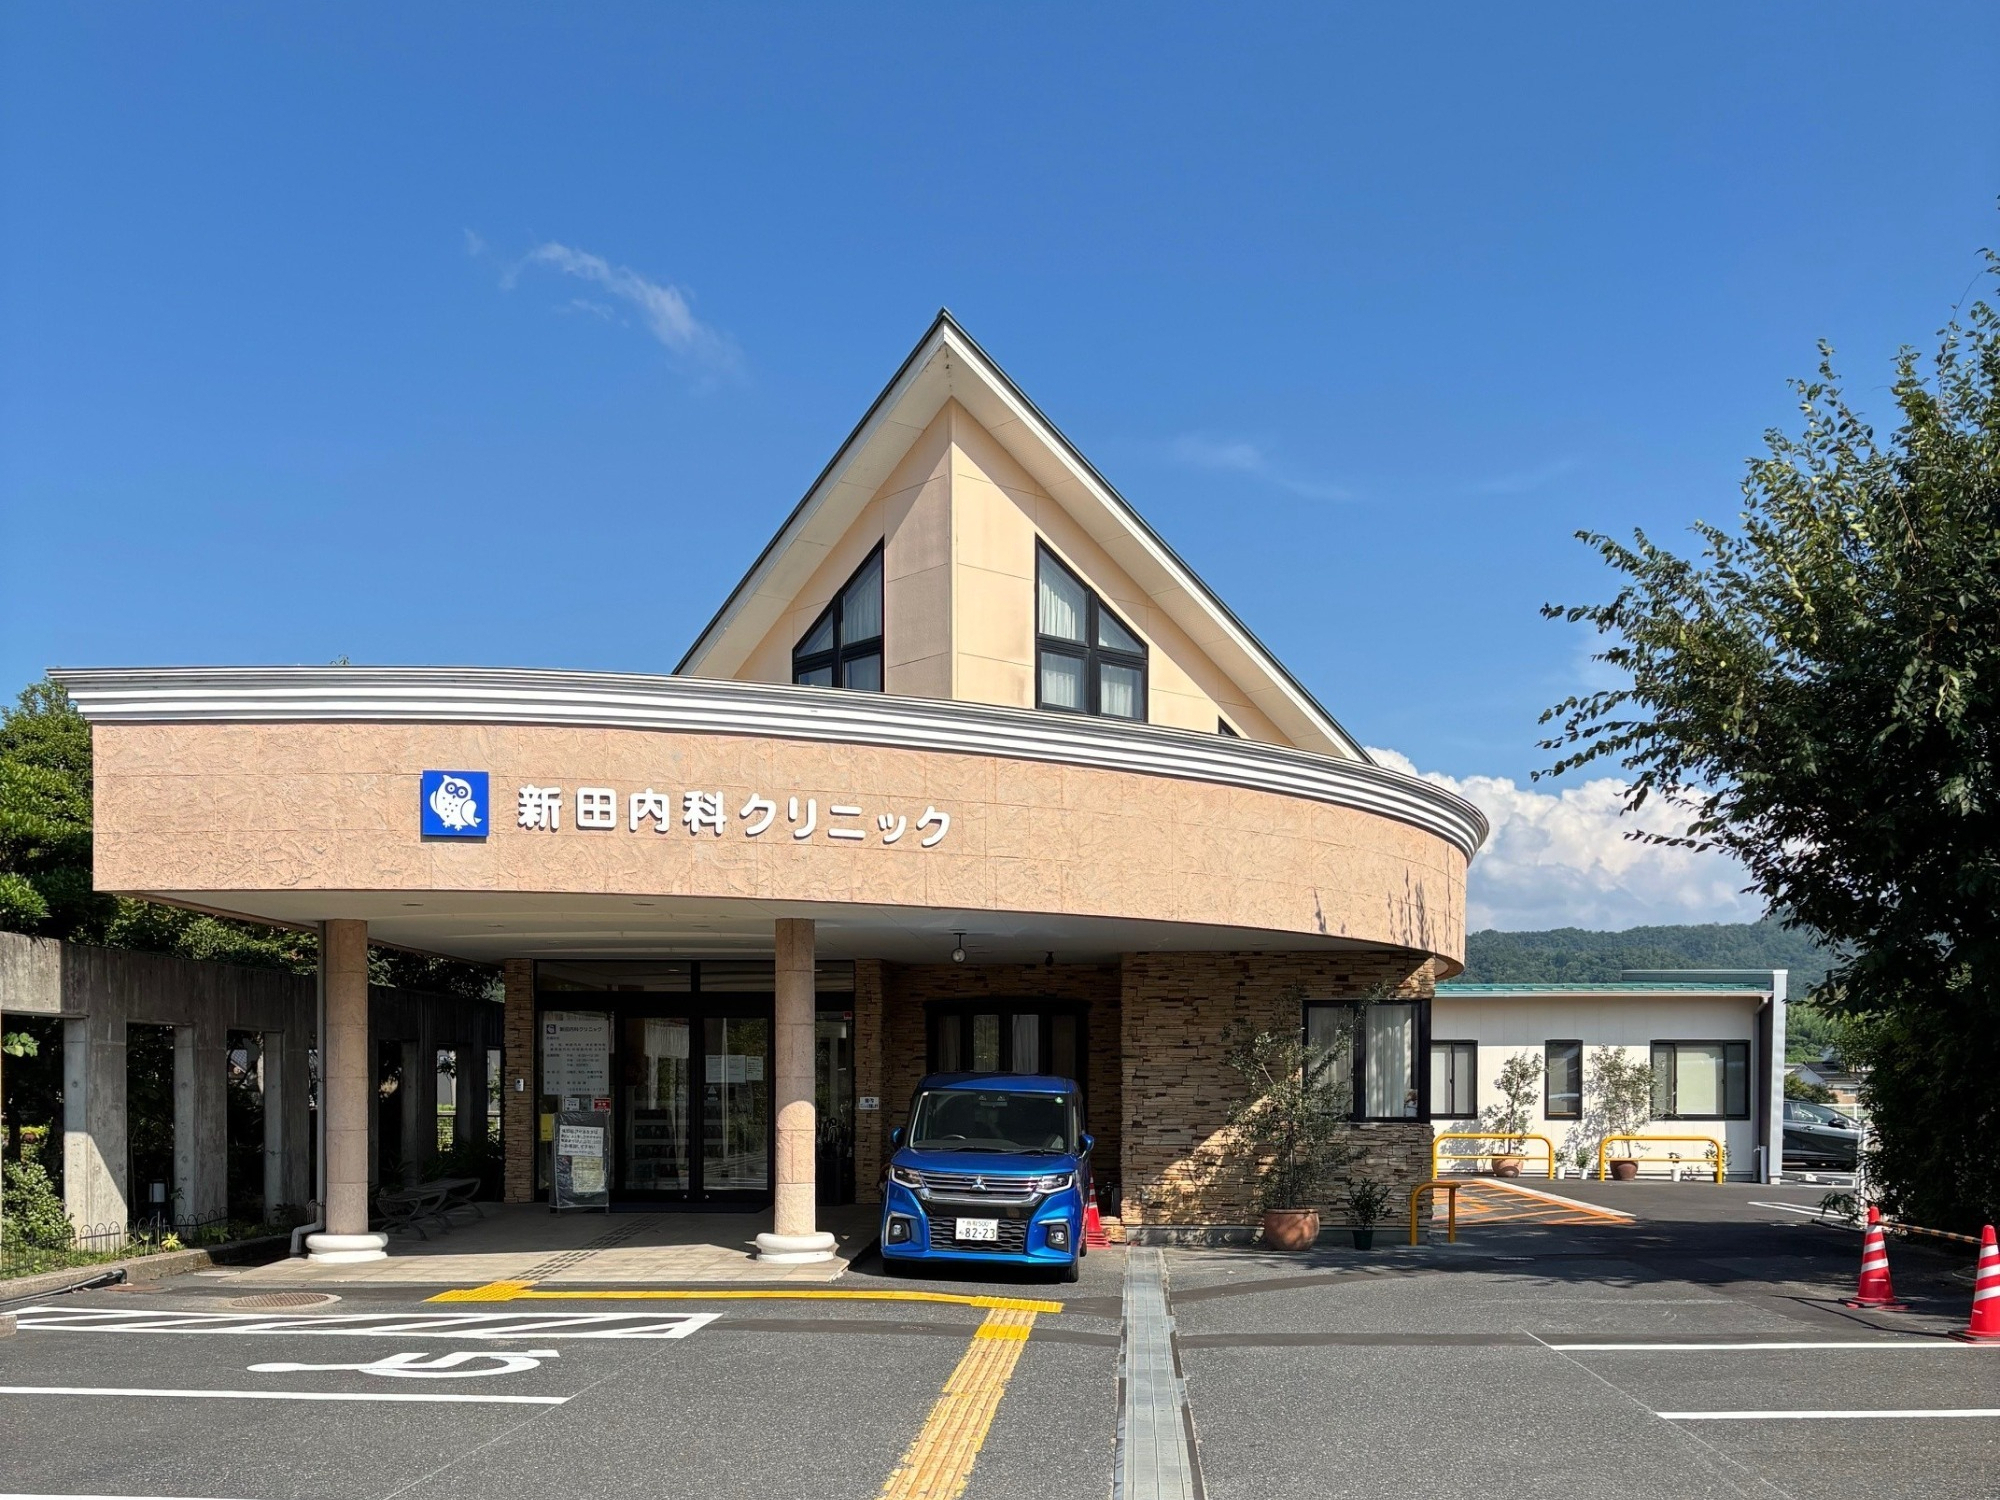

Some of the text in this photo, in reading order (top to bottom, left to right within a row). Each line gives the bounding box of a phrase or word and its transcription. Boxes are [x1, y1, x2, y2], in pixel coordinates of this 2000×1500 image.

[517, 784, 951, 848] 新田内科クリニック
